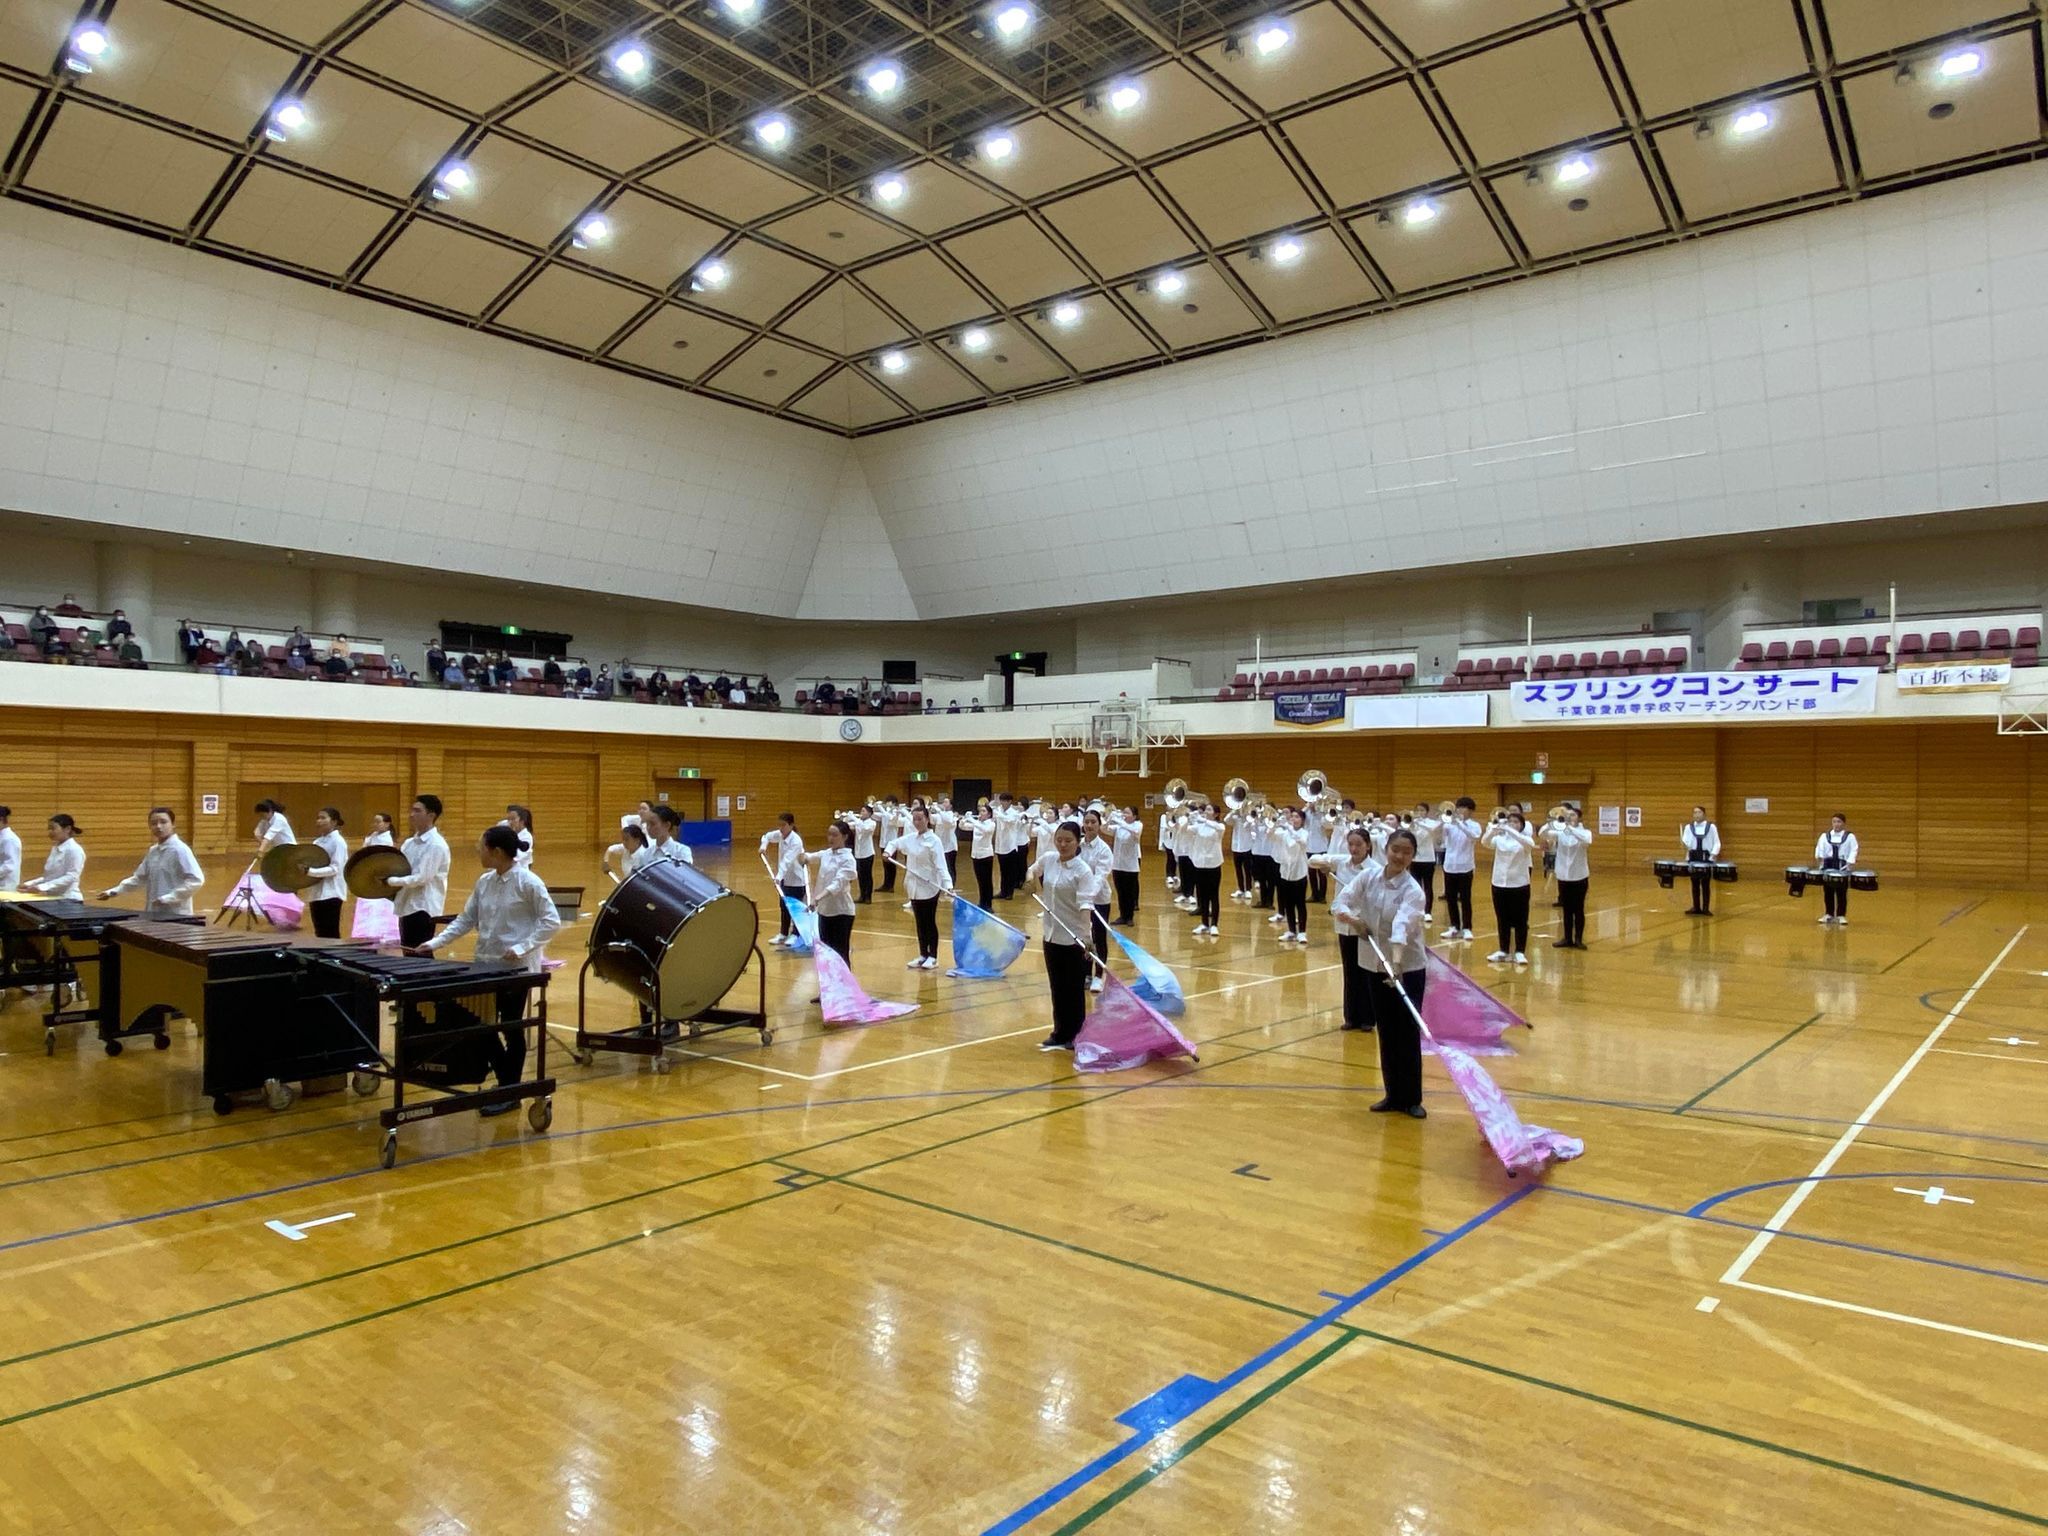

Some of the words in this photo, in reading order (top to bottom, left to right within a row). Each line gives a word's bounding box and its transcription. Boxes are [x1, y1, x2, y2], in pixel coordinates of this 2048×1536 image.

[1524, 672, 1859, 703] スプリングコンサート
[1557, 698, 1817, 717] 千葉敬愛高等学校マーチングバンド部
